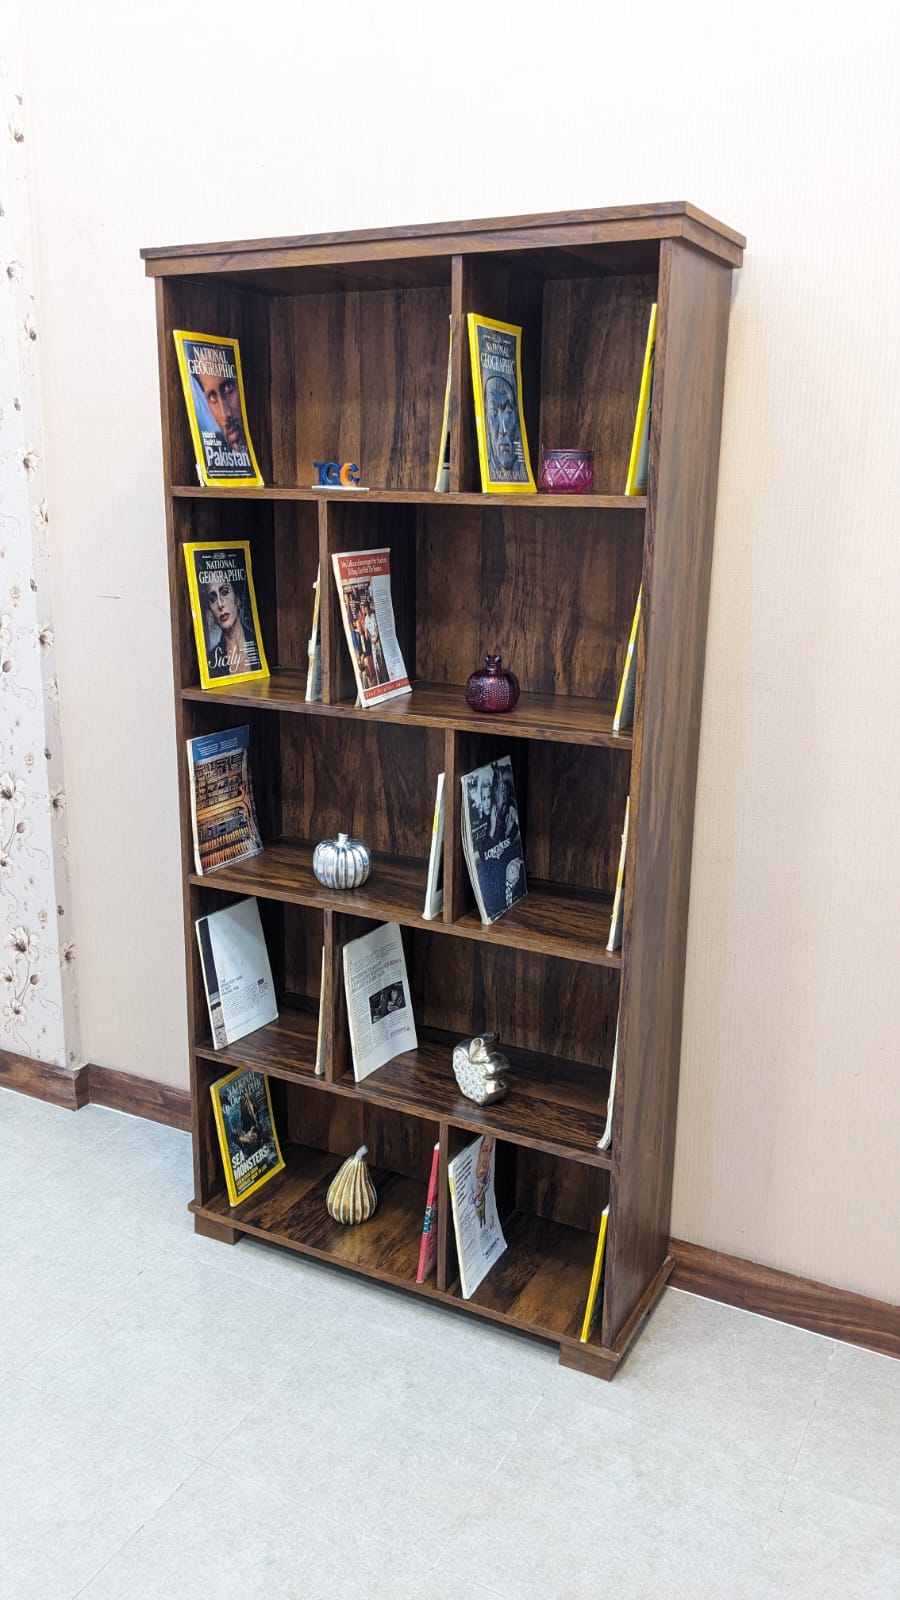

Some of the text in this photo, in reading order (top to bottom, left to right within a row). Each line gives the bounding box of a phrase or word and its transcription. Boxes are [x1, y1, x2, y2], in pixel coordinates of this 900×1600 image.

[193, 346, 228, 364] NATIONAL
[486, 341, 510, 358] NATIONAL
[188, 359, 237, 379] GEOGRAPHIC
[480, 352, 515, 374] GEOGRAPHIC
[205, 446, 251, 468] Pakistan
[205, 559, 237, 570] NATIONAL
[198, 568, 245, 584] GEOGRAPHIC
[208, 644, 241, 673] Sicily
[484, 839, 510, 860] LONGINES
[226, 1071, 257, 1096] NATIONAL
[232, 1150, 245, 1168] SEA
[233, 1144, 268, 1181] MONSTERS
